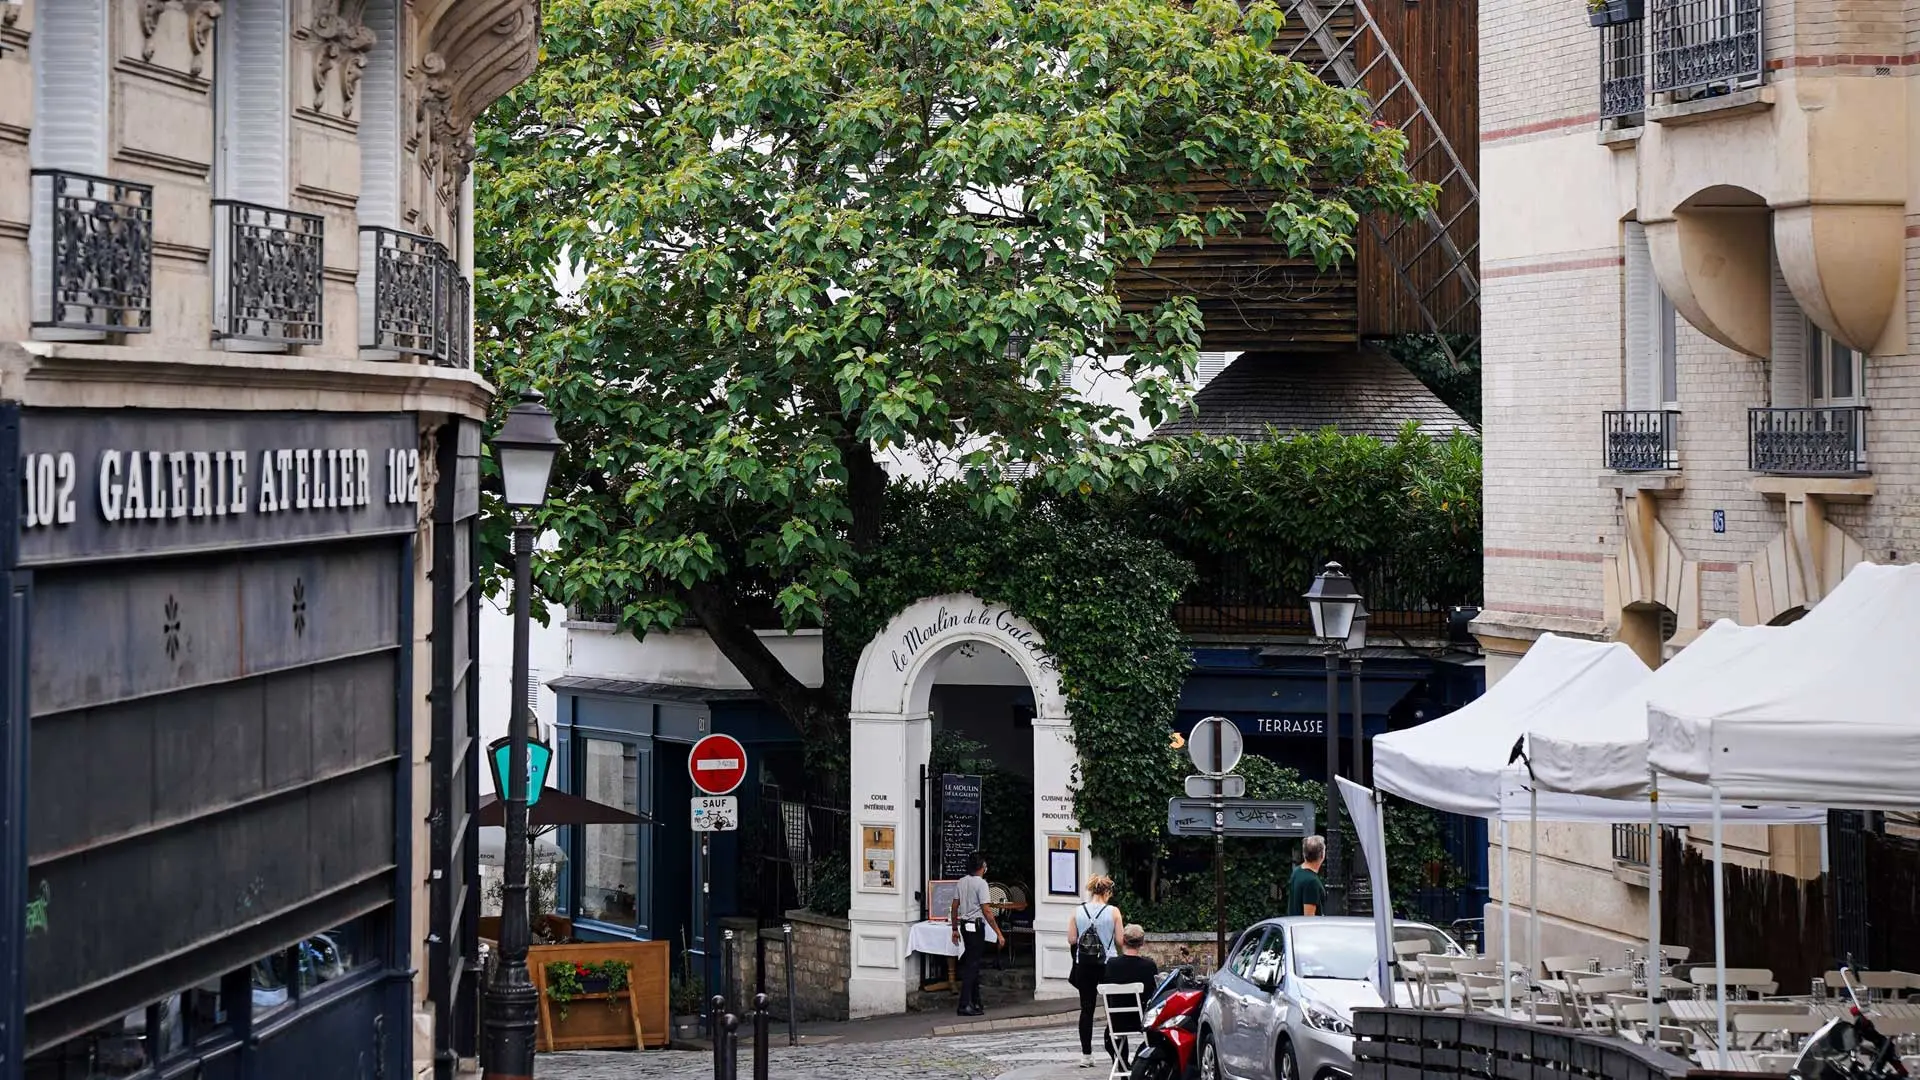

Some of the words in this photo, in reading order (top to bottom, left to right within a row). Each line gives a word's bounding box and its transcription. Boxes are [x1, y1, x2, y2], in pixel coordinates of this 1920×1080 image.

[24, 450, 76, 527] 102
[100, 448, 247, 522] GALERIE
[259, 447, 371, 512] ATELIER
[388, 447, 419, 503] 102
[1713, 511, 1724, 531] 85
[891, 649, 908, 673] le
[903, 606, 960, 655] Moulin
[963, 608, 976, 624] de
[978, 608, 991, 625] la
[1257, 718, 1324, 733] TERRASSE
[953, 784, 979, 792] MOULIN
[702, 799, 727, 808] SAUF
